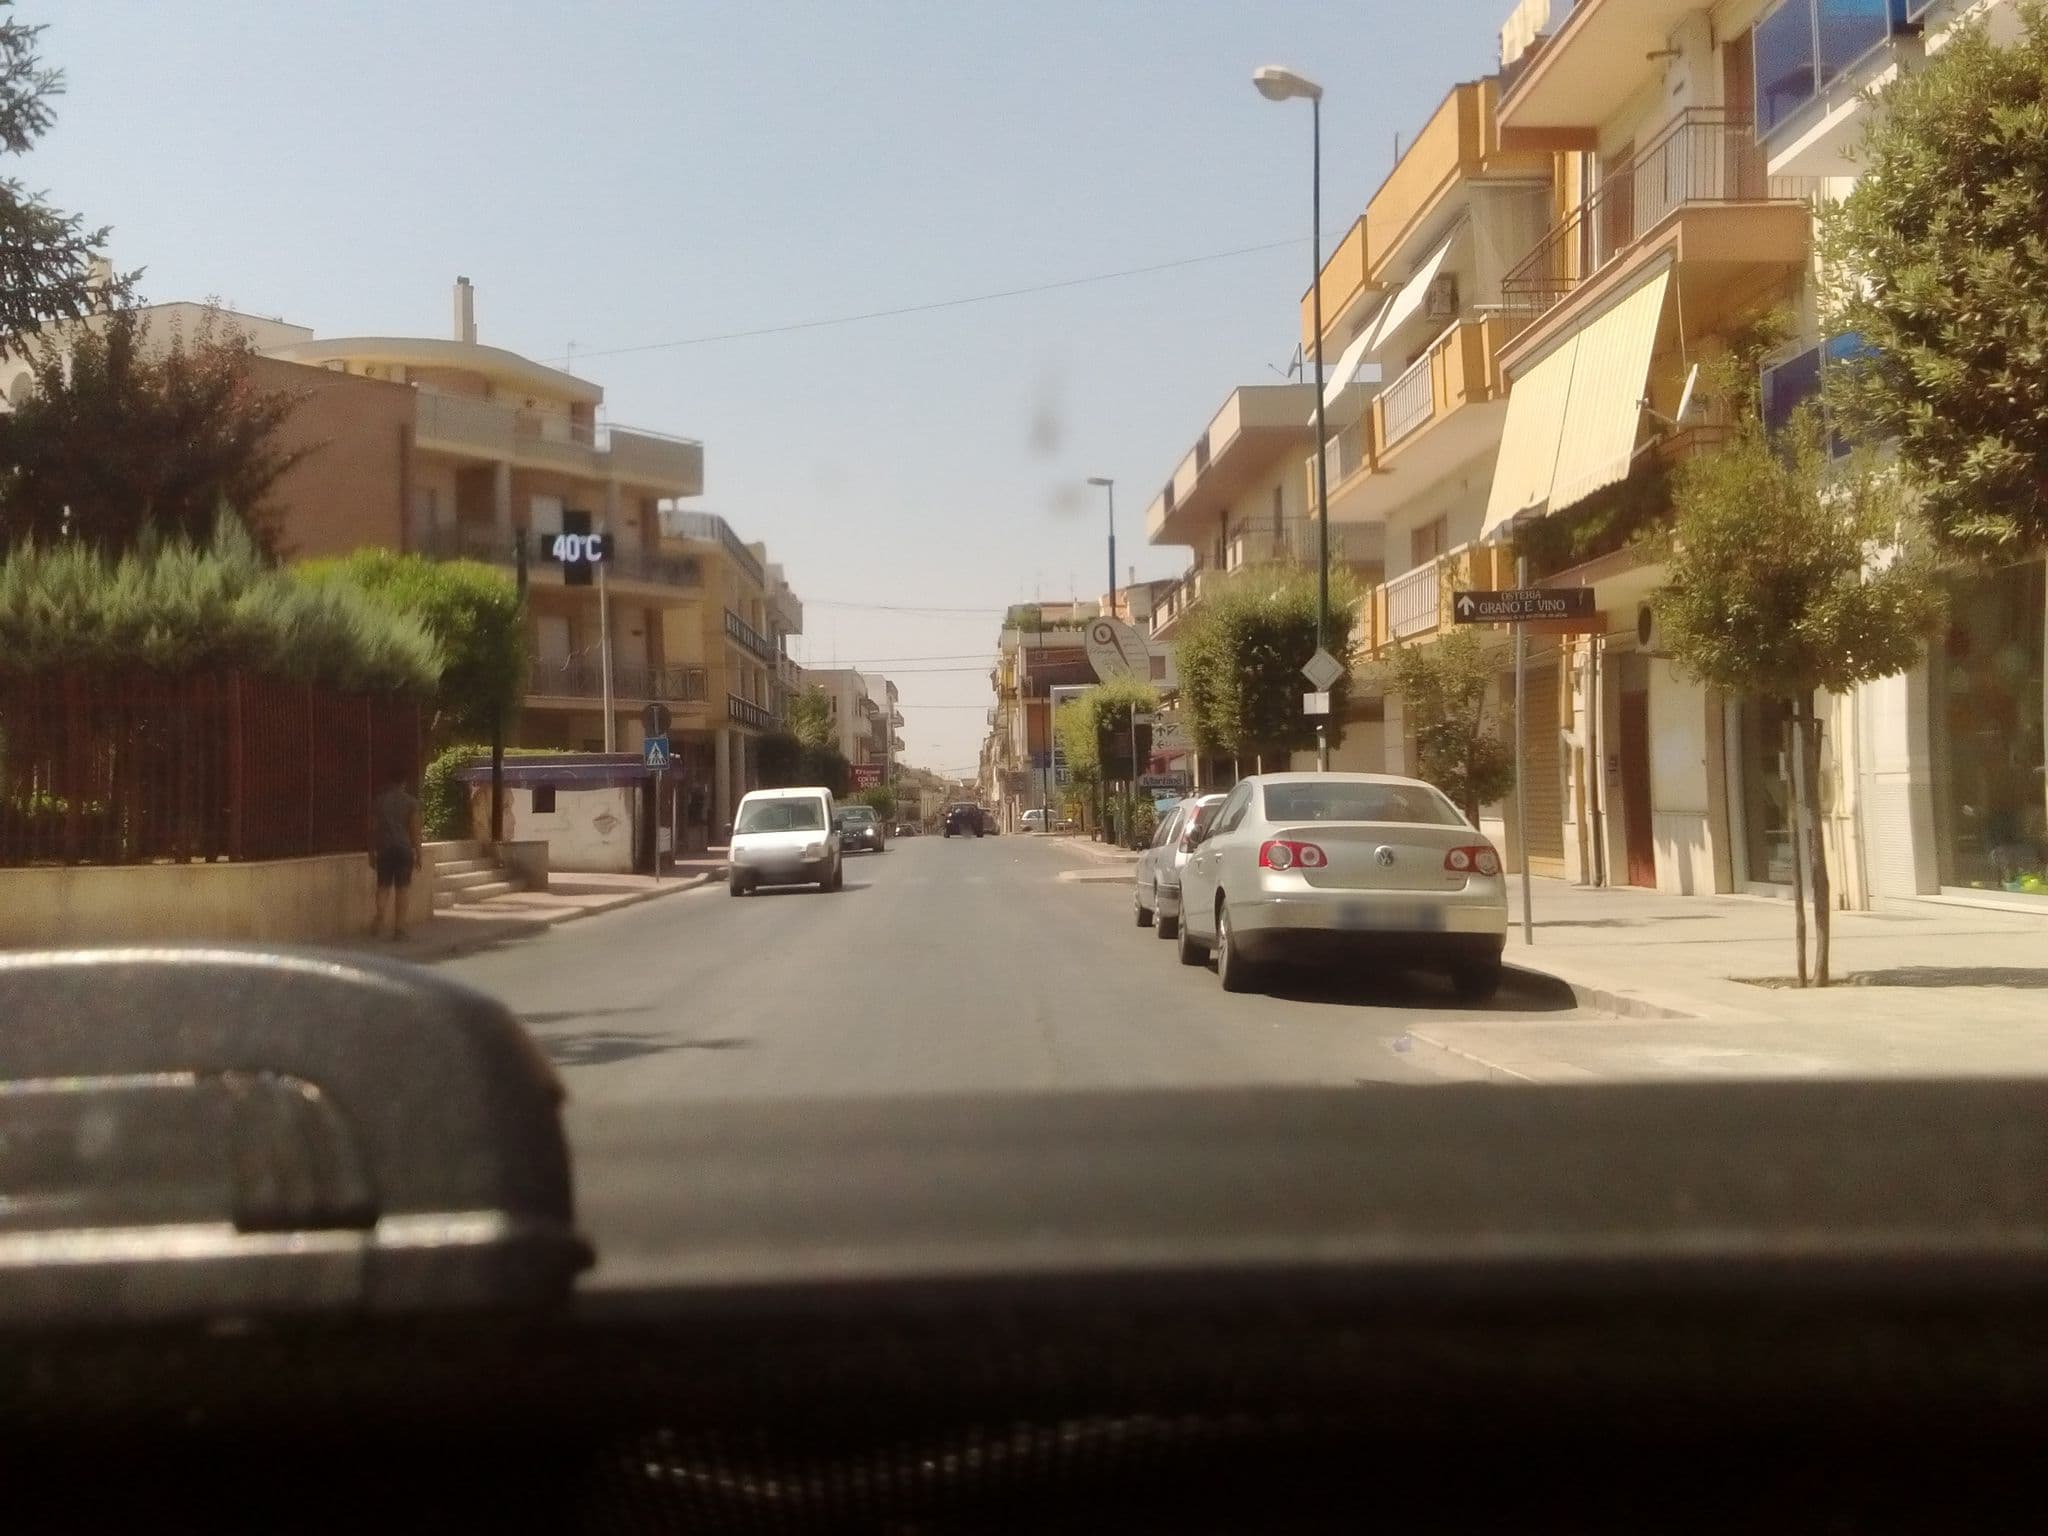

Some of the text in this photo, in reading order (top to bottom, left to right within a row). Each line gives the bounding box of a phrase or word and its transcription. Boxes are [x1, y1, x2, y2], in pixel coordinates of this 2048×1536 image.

[552, 533, 602, 563] 40°C
[1501, 590, 1542, 601] OSTERIA
[1479, 599, 1566, 614] GRANO E VINO
